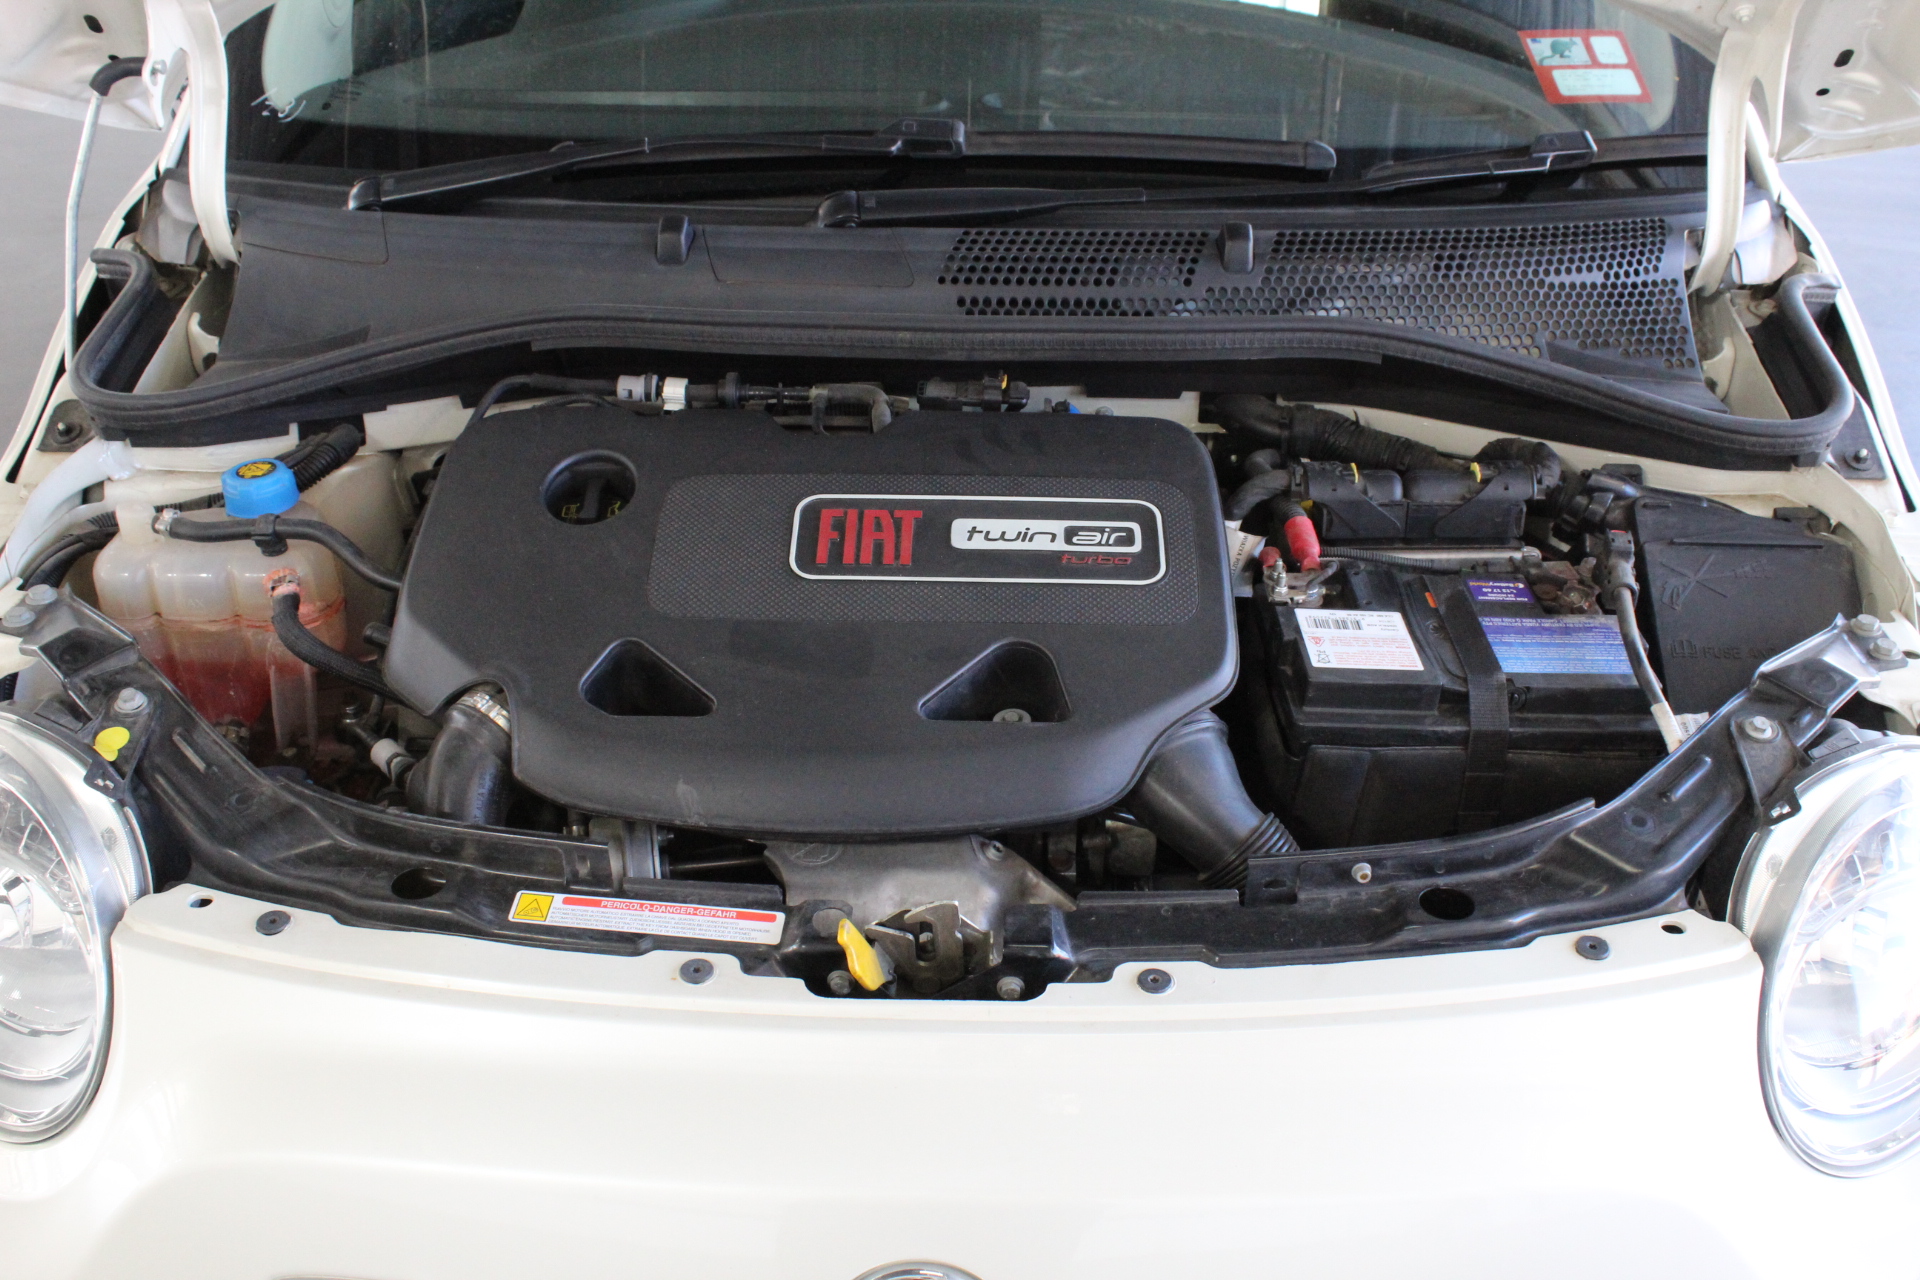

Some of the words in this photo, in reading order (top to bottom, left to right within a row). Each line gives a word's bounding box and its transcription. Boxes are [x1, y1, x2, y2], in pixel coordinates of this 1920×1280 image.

[815, 508, 923, 566] FIAT
[1061, 554, 1133, 566] turbo
[1703, 646, 1741, 659] FUSE
